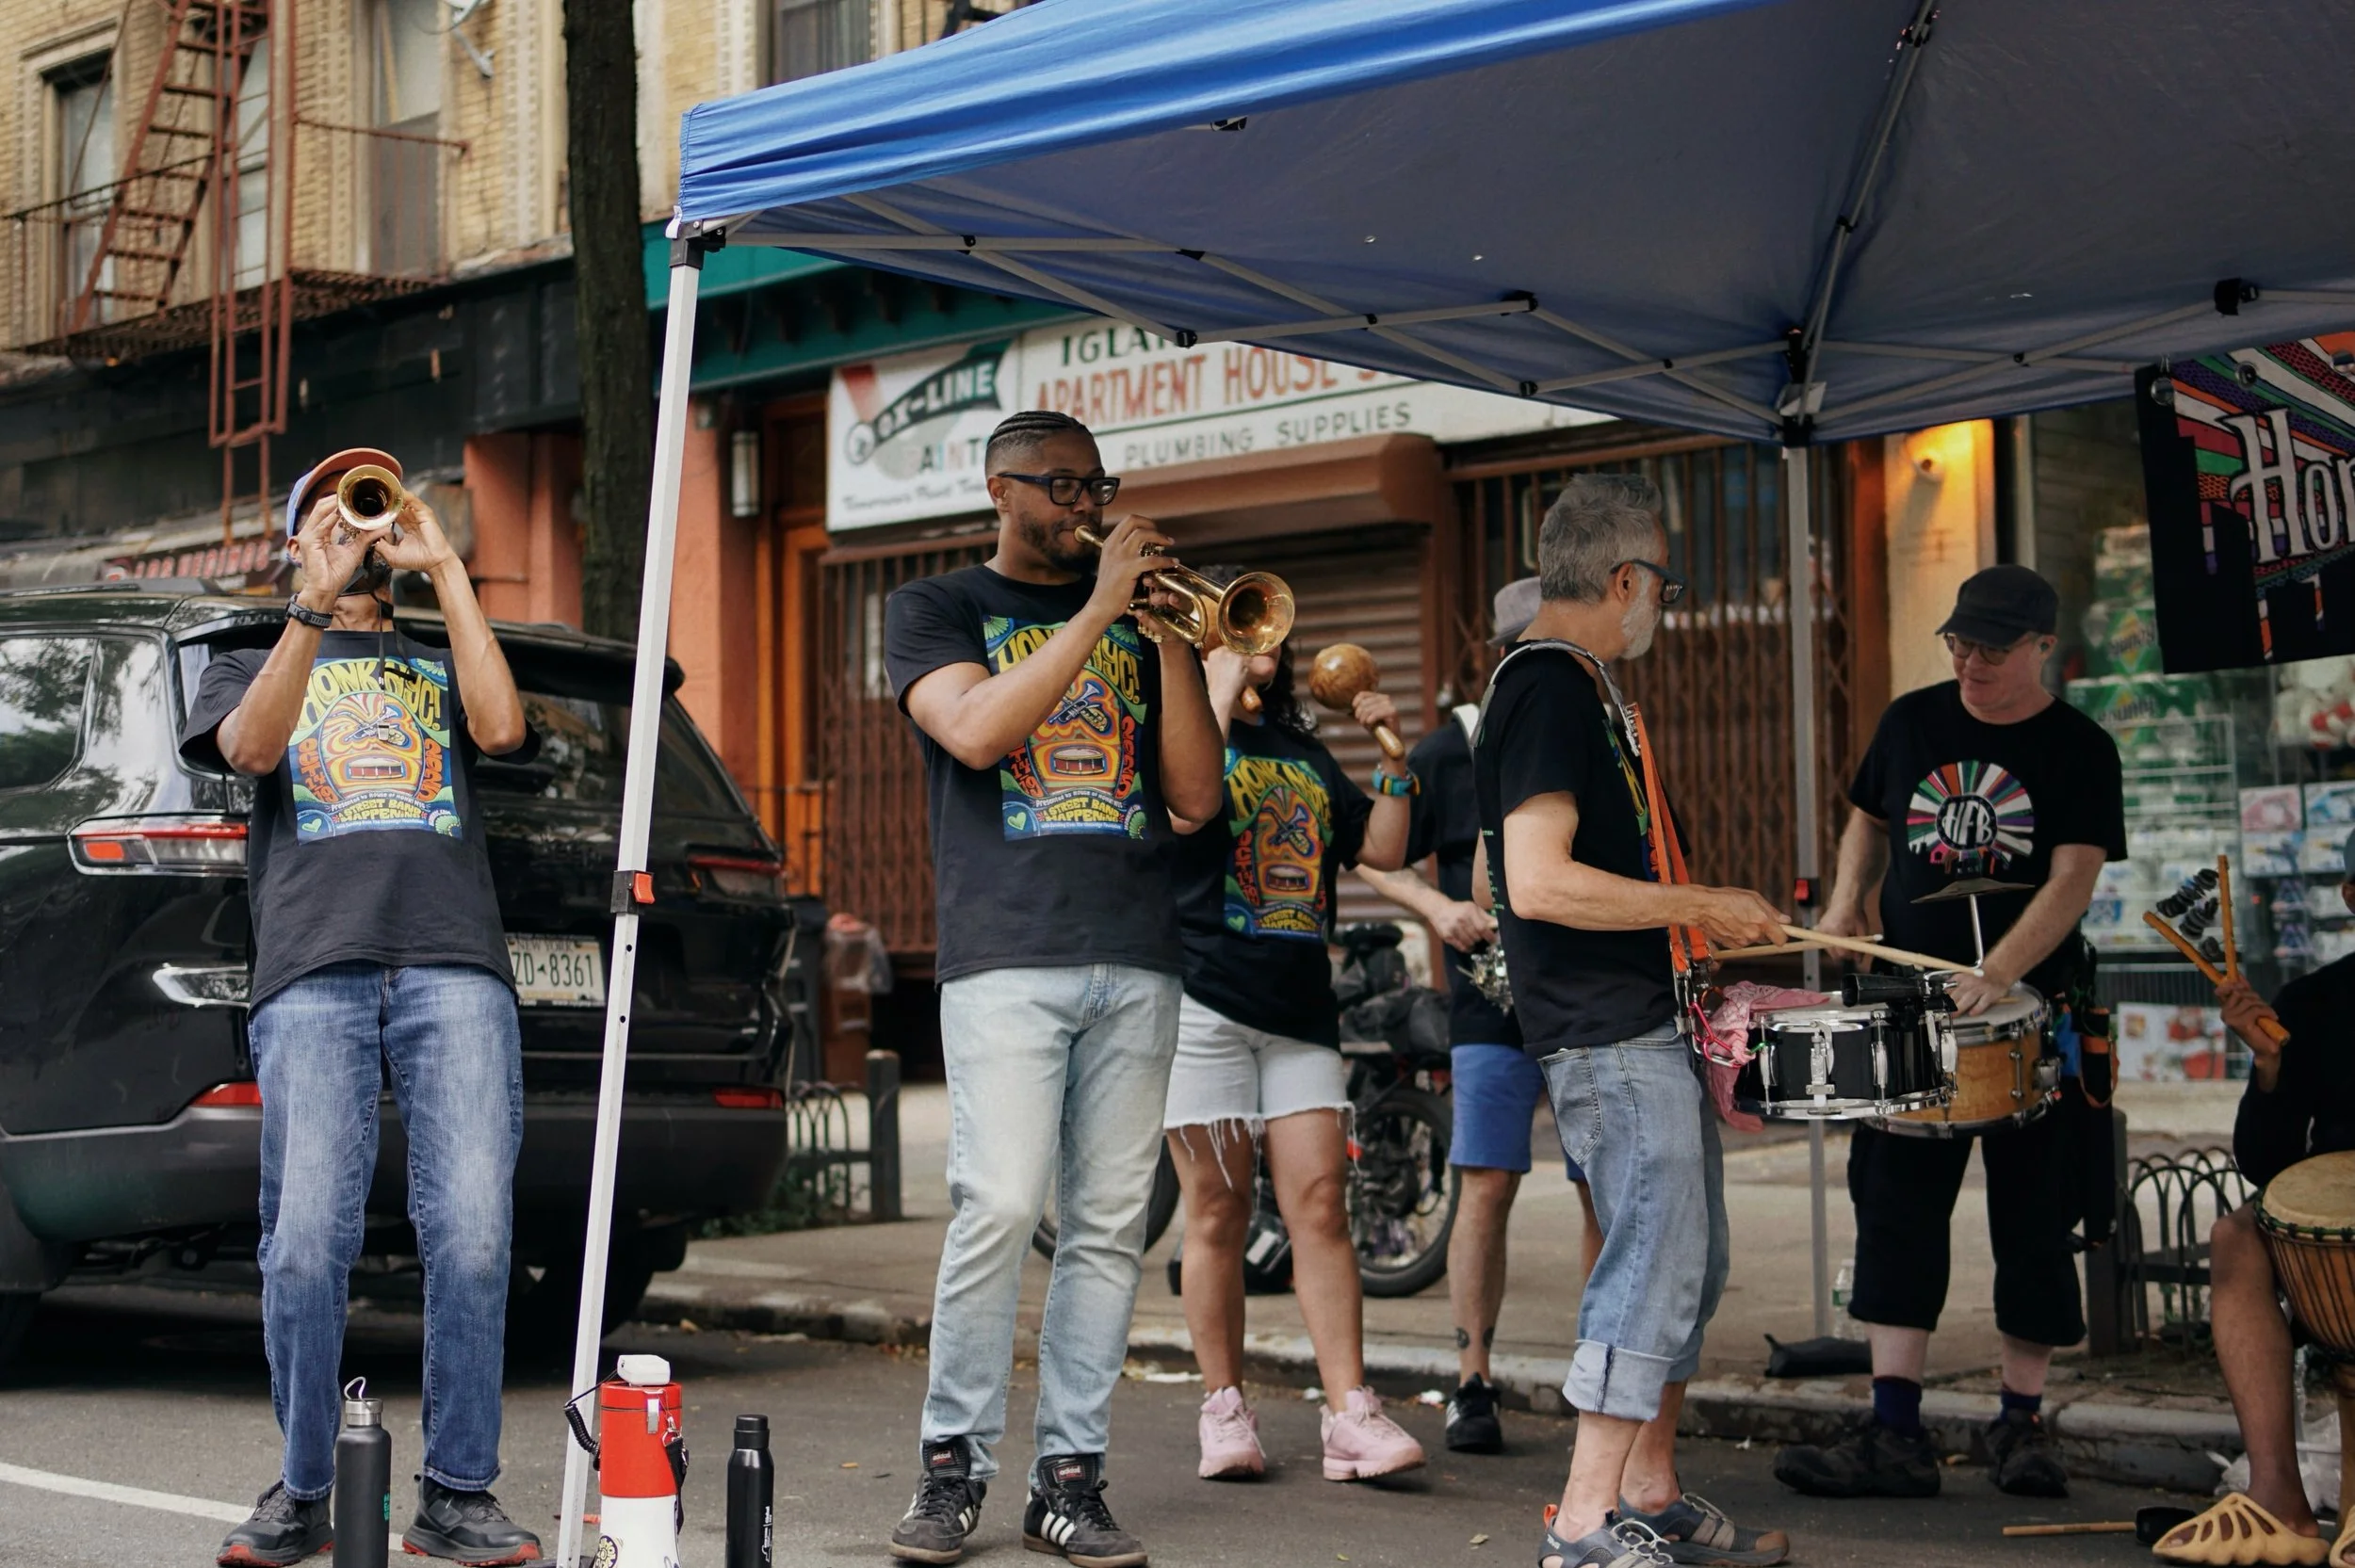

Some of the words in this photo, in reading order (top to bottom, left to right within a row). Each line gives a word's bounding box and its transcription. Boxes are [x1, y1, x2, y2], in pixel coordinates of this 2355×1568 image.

[1036, 354, 1208, 427] APARTMENT
[1125, 426, 1254, 469] PLUMBING
[1276, 401, 1412, 446] SUPPLIES
[344, 799, 385, 818] STREET
[389, 799, 422, 818] BAND
[1048, 797, 1089, 817] STREET
[1092, 799, 1120, 818] BAND
[517, 940, 541, 952] NEW
[545, 941, 574, 953] YORK
